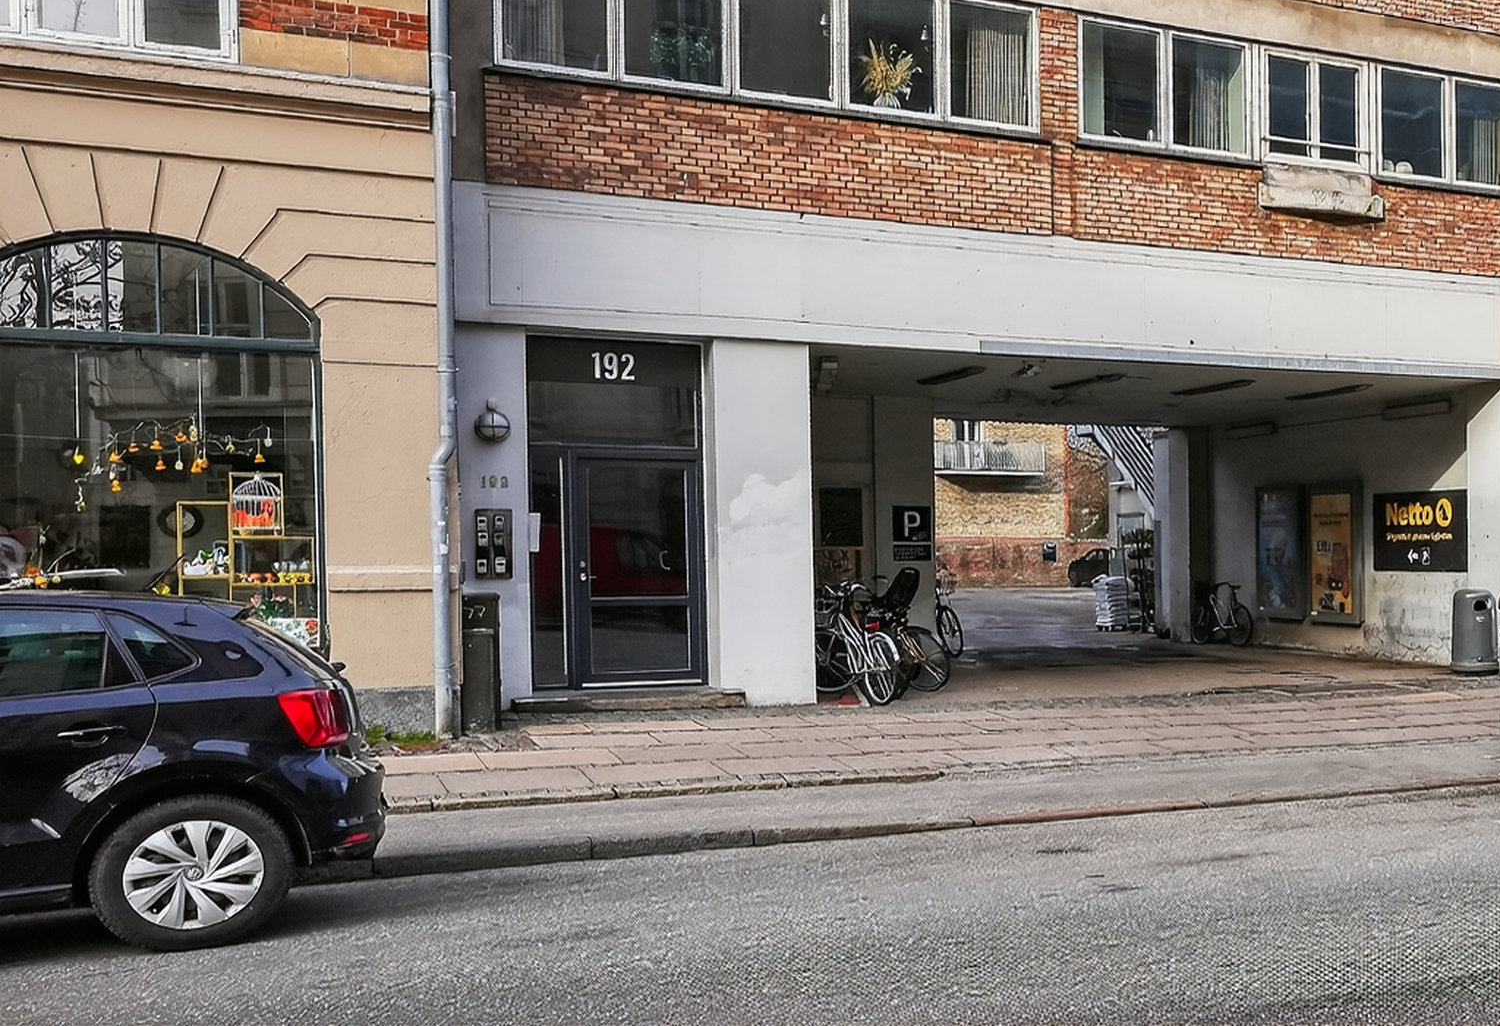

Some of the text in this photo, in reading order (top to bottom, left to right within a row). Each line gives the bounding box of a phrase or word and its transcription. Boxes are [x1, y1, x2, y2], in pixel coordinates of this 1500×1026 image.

[591, 352, 636, 381] 192
[904, 511, 921, 537] P
[1385, 501, 1434, 526] Netto
